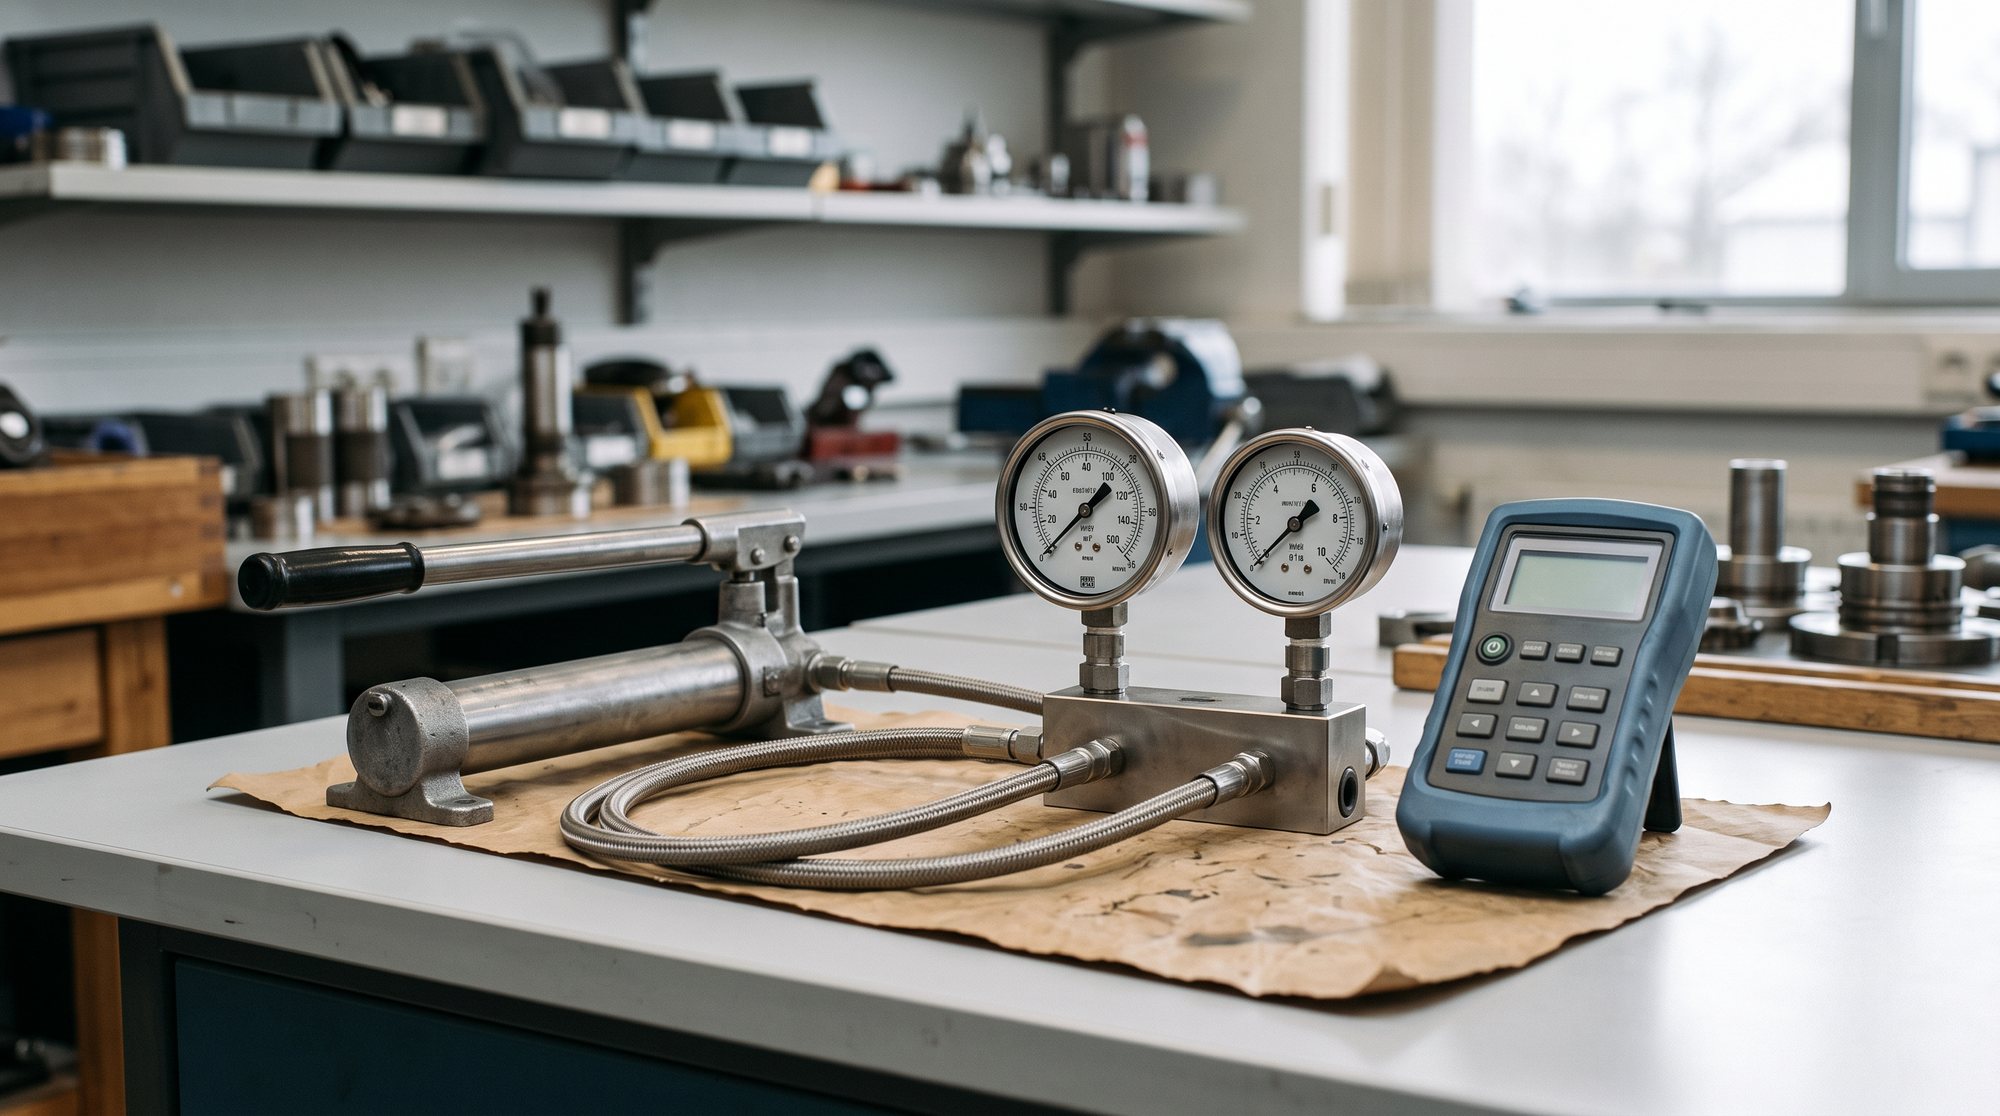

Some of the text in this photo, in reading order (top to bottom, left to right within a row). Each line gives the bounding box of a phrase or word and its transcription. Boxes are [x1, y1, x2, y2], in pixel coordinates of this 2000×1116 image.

[1081, 462, 1091, 472] 40
[1060, 471, 1070, 481] 60
[1101, 471, 1115, 481] 100
[1273, 484, 1279, 494] 4
[1311, 483, 1317, 493] 6
[1047, 489, 1057, 499] 40
[1116, 491, 1128, 501] 120
[1019, 502, 1028, 511] 50
[1047, 514, 1057, 524] 20
[1117, 515, 1130, 525] 140
[1255, 515, 1261, 525] 2
[1332, 513, 1338, 524] 8
[1106, 534, 1120, 544] 500
[1231, 531, 1239, 539] 10
[1317, 547, 1326, 557] 10
[1039, 553, 1044, 562] 0
[1249, 564, 1254, 572] 0
[1338, 572, 1346, 580] 18
